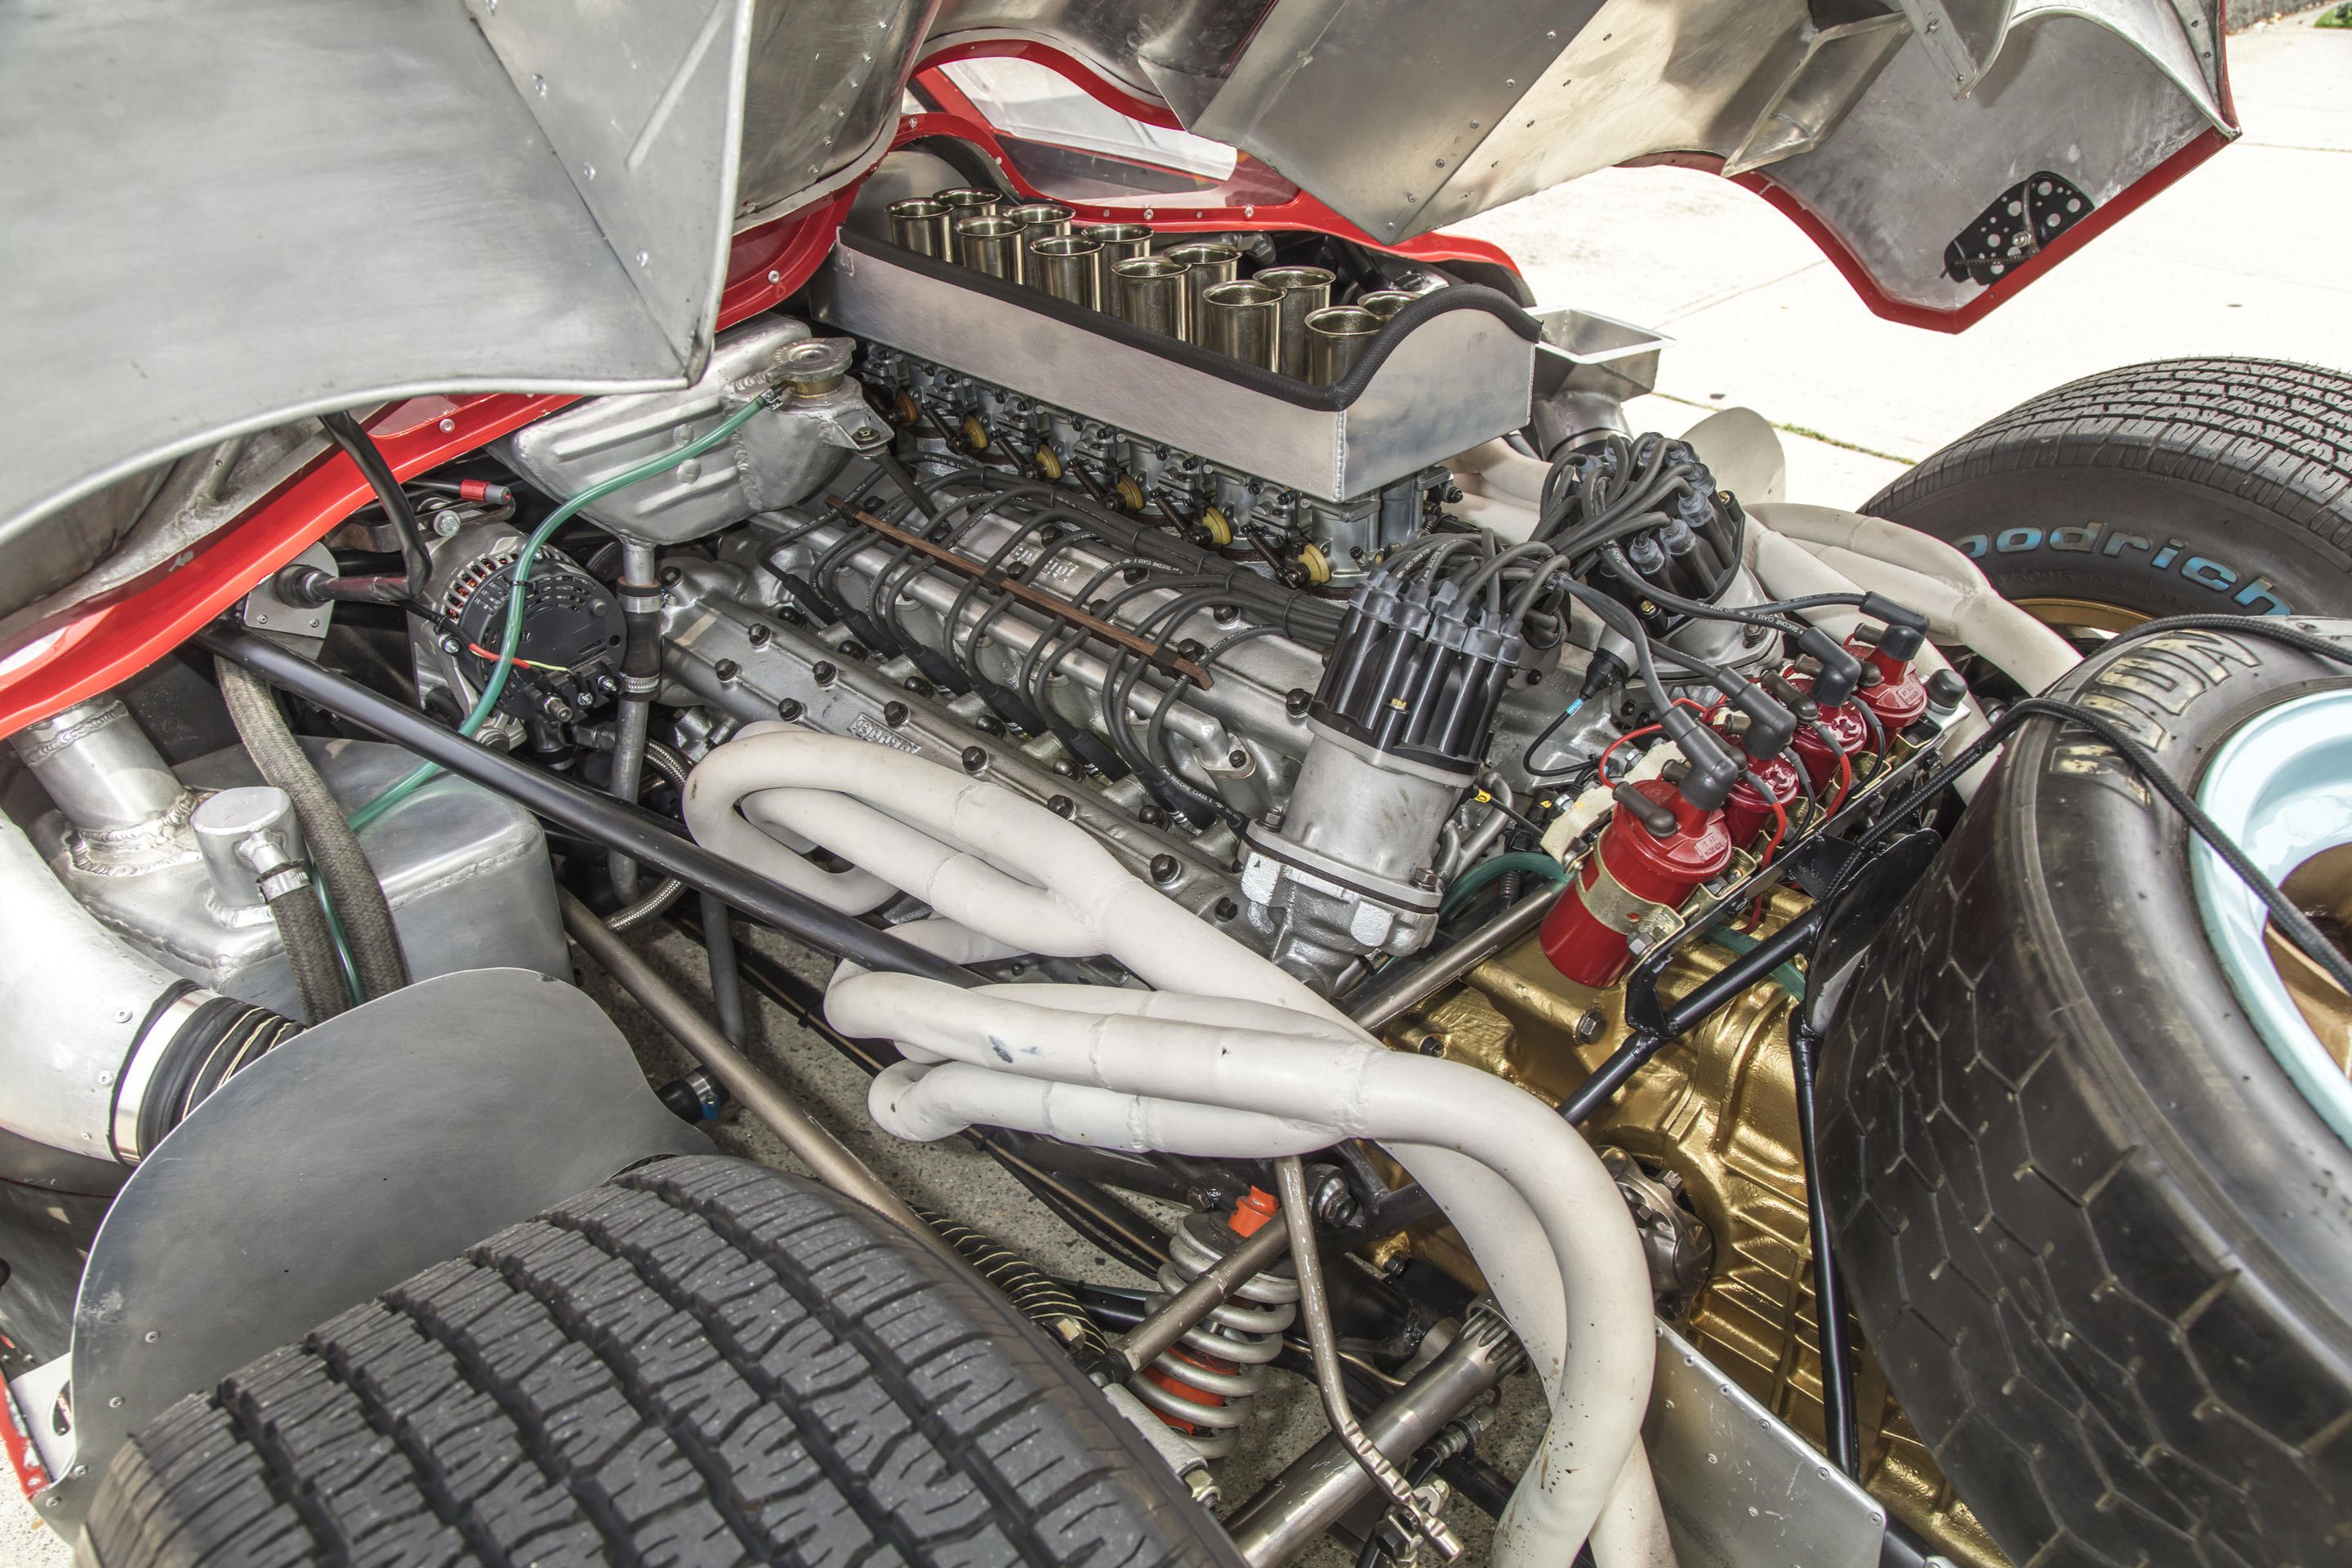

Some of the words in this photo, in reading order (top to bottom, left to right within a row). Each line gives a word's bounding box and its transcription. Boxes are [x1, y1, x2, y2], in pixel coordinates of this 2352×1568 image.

[1152, 561, 1171, 571] SILICONE
[1757, 613, 1775, 622] CLASS
[1776, 618, 1799, 633] SILICONE
[1170, 775, 1191, 791] SILICONE
[1192, 790, 1208, 800] CLASS
